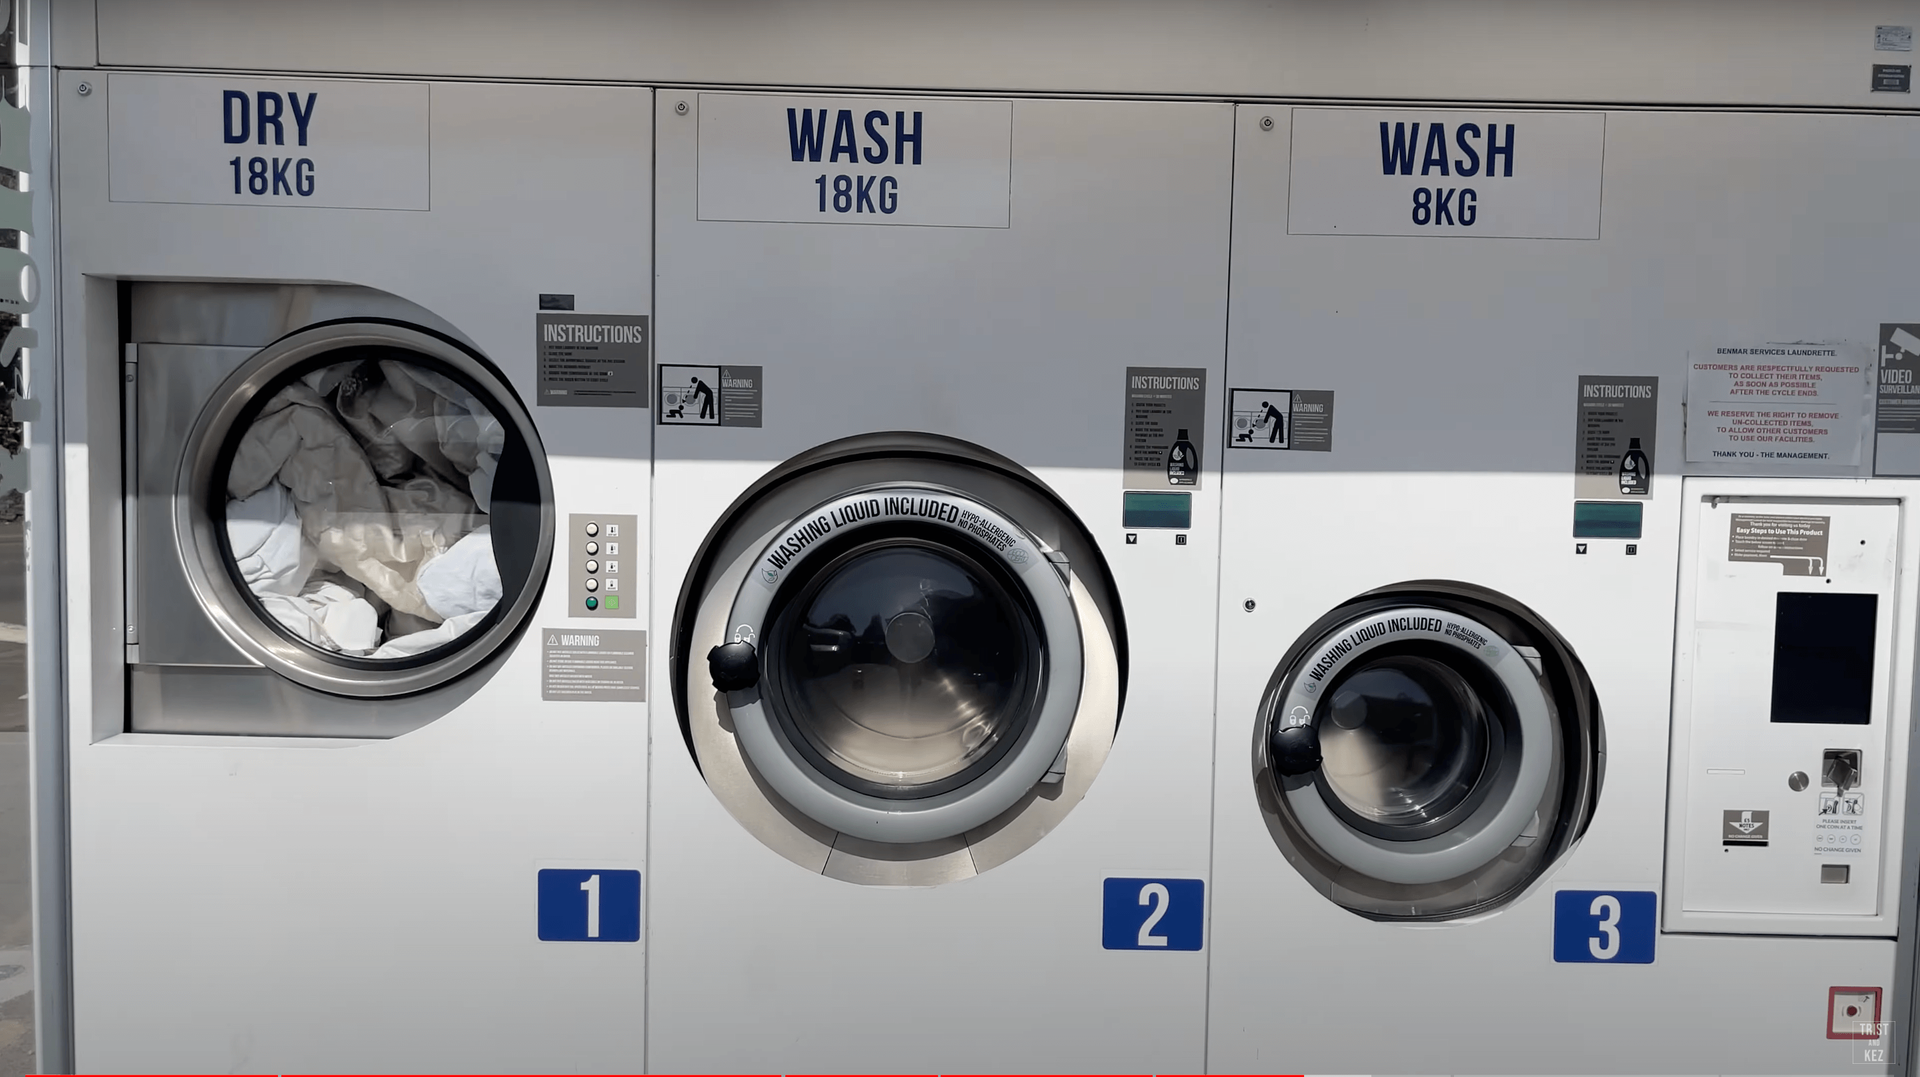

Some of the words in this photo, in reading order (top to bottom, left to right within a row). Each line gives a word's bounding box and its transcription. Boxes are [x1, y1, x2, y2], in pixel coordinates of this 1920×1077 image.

[223, 90, 318, 147] DRY
[787, 108, 923, 165] WASH
[1380, 121, 1515, 177] WASH
[229, 156, 315, 197] 18KG
[815, 174, 898, 215] 18KG
[1412, 187, 1477, 226] 8KG
[544, 324, 642, 344] INSTRUCTIONS
[722, 378, 752, 388] WARNING
[1132, 376, 1200, 390] INSTRUCTIONS
[1583, 384, 1652, 399] INSTRUCTIONS
[1881, 369, 1912, 384] VIDEO
[1293, 403, 1324, 413] WARNING
[767, 516, 831, 570] WASHING
[830, 499, 880, 528] LIQUID
[884, 497, 959, 524] INCLUDED
[958, 519, 968, 528] NO
[968, 523, 1006, 551] PHOSPHATES
[961, 510, 1016, 547] HYPO-ALLERGENIC
[561, 634, 600, 646] WARNING
[1309, 639, 1352, 681] WASHING
[1350, 622, 1386, 646] LIQUID
[1388, 617, 1442, 632] INCLUDED
[1447, 622, 1488, 645] HYPO-ALLERGENIC
[1452, 631, 1481, 649] PHOSPHATES
[580, 874, 600, 938] 1
[1138, 885, 1171, 947] 2
[1588, 894, 1621, 960] 3
